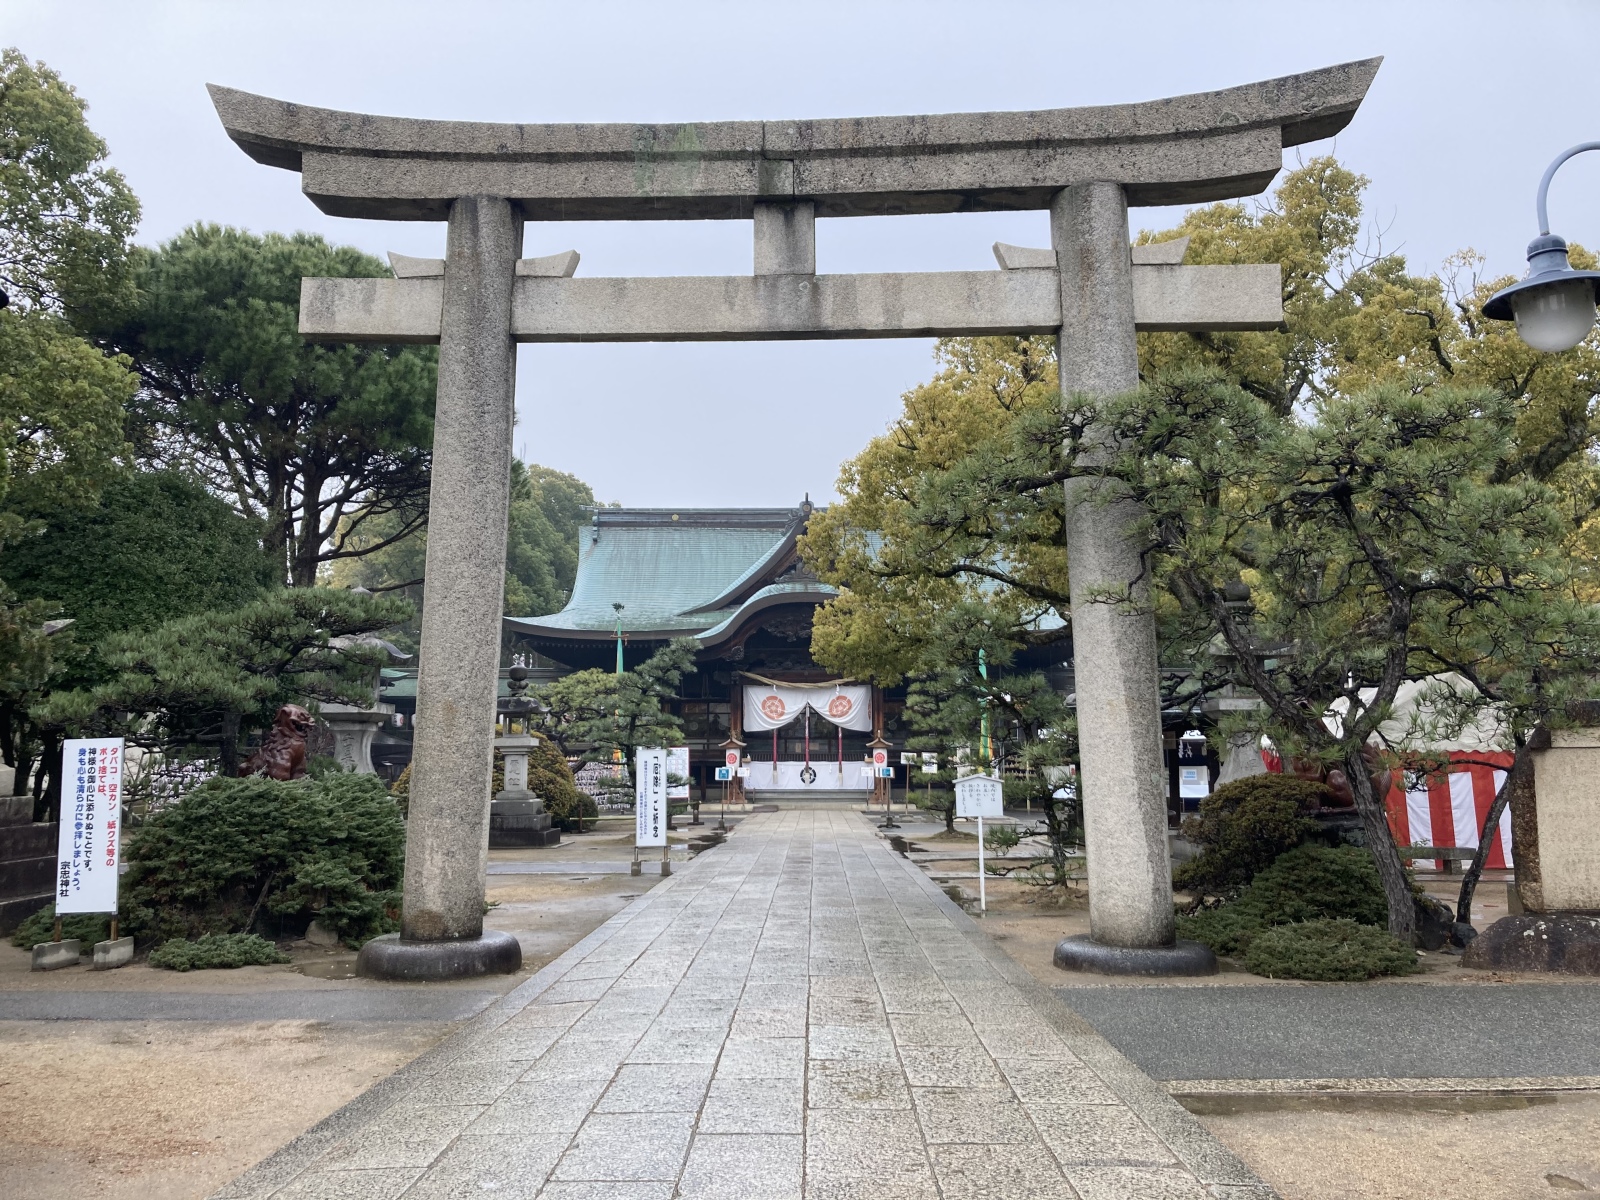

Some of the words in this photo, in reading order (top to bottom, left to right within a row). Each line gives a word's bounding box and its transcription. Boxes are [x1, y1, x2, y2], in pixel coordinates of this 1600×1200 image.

[72, 748, 87, 891] 身も心も清らかに参拝しましょう。
[83, 747, 97, 872] 神様の御心に添わぬことです。
[59, 861, 70, 897] 宗忠神社
